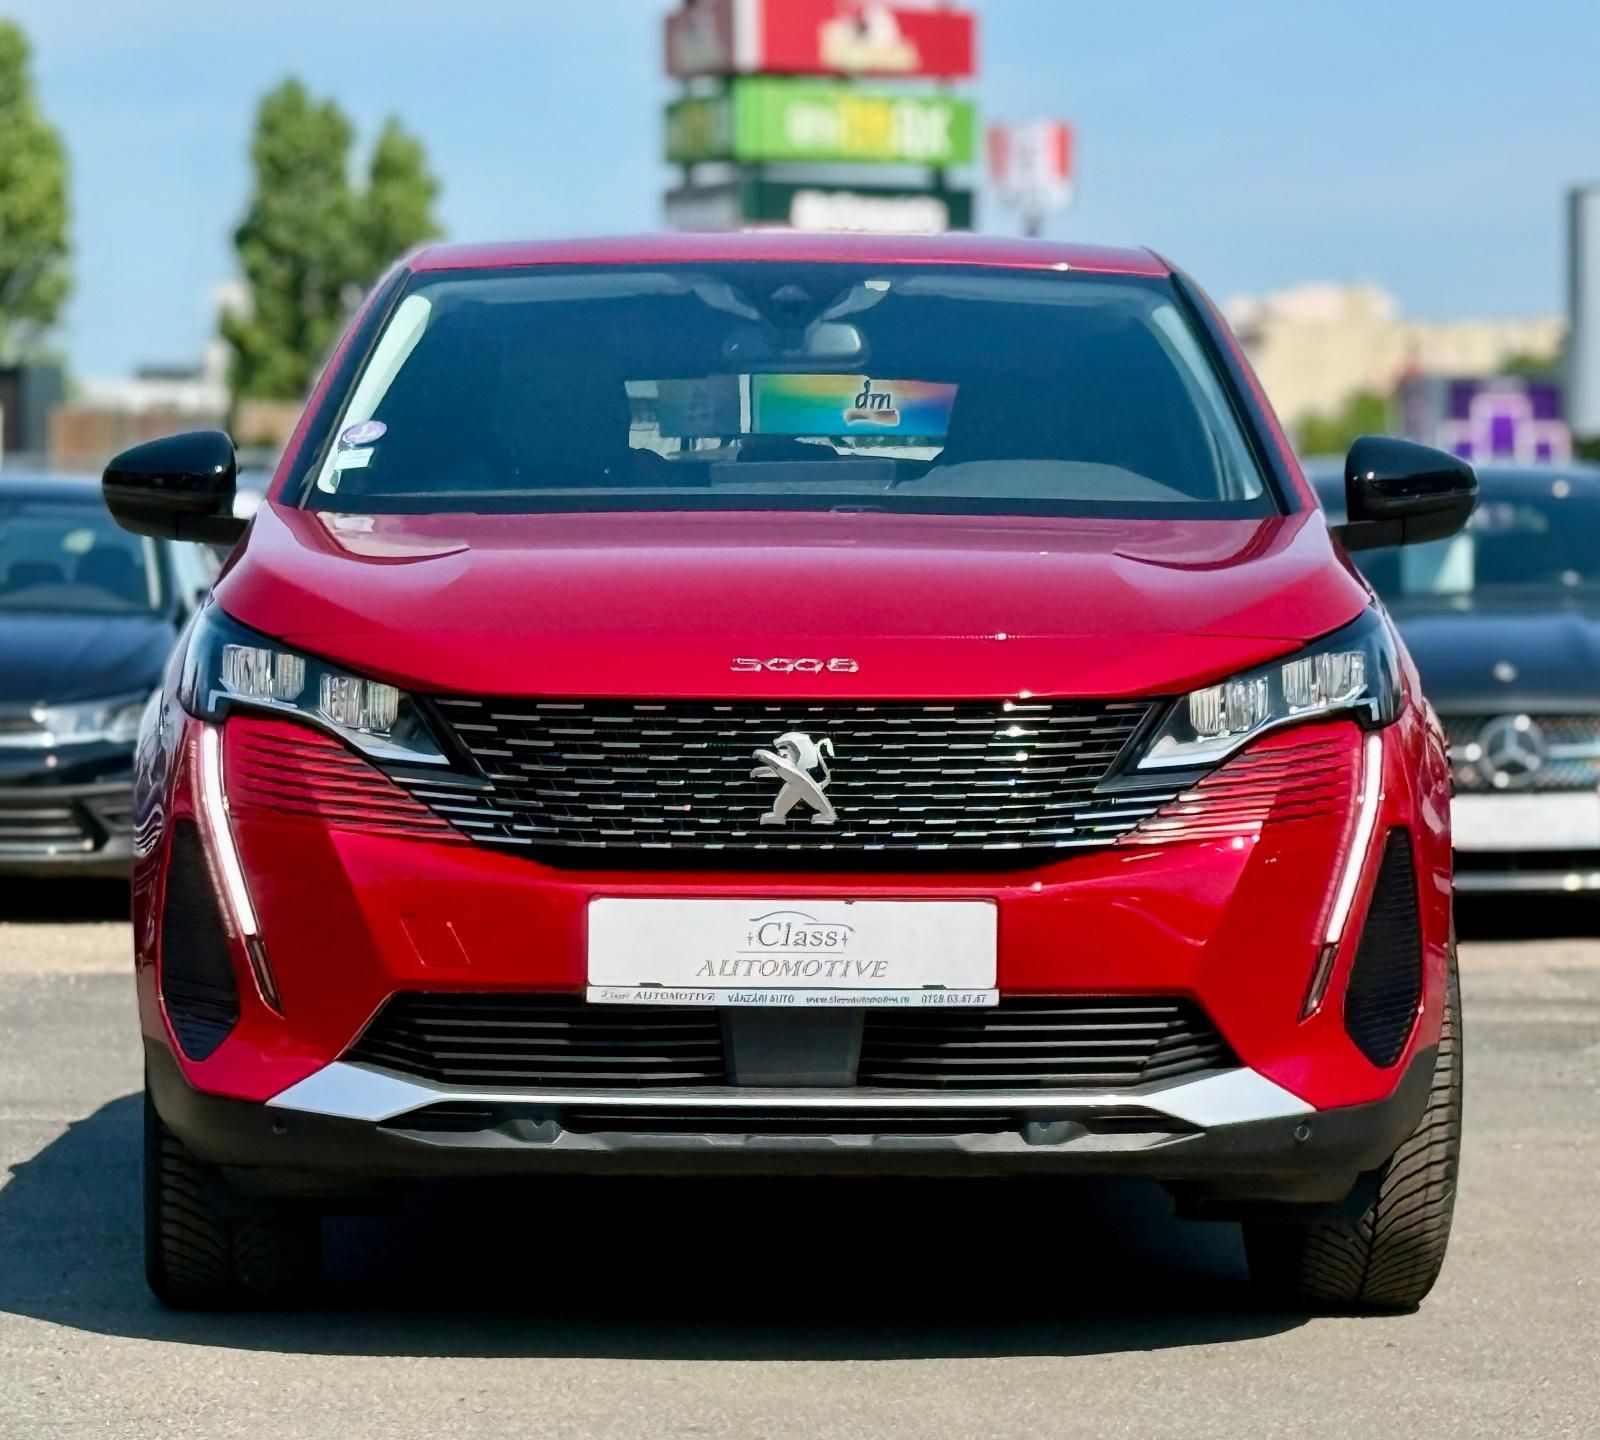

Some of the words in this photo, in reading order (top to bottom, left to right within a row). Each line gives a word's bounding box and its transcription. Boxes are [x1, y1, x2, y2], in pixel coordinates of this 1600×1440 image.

[855, 380, 890, 409] dm
[757, 922, 838, 947] Class
[696, 959, 889, 978] AUTOMOTIVE
